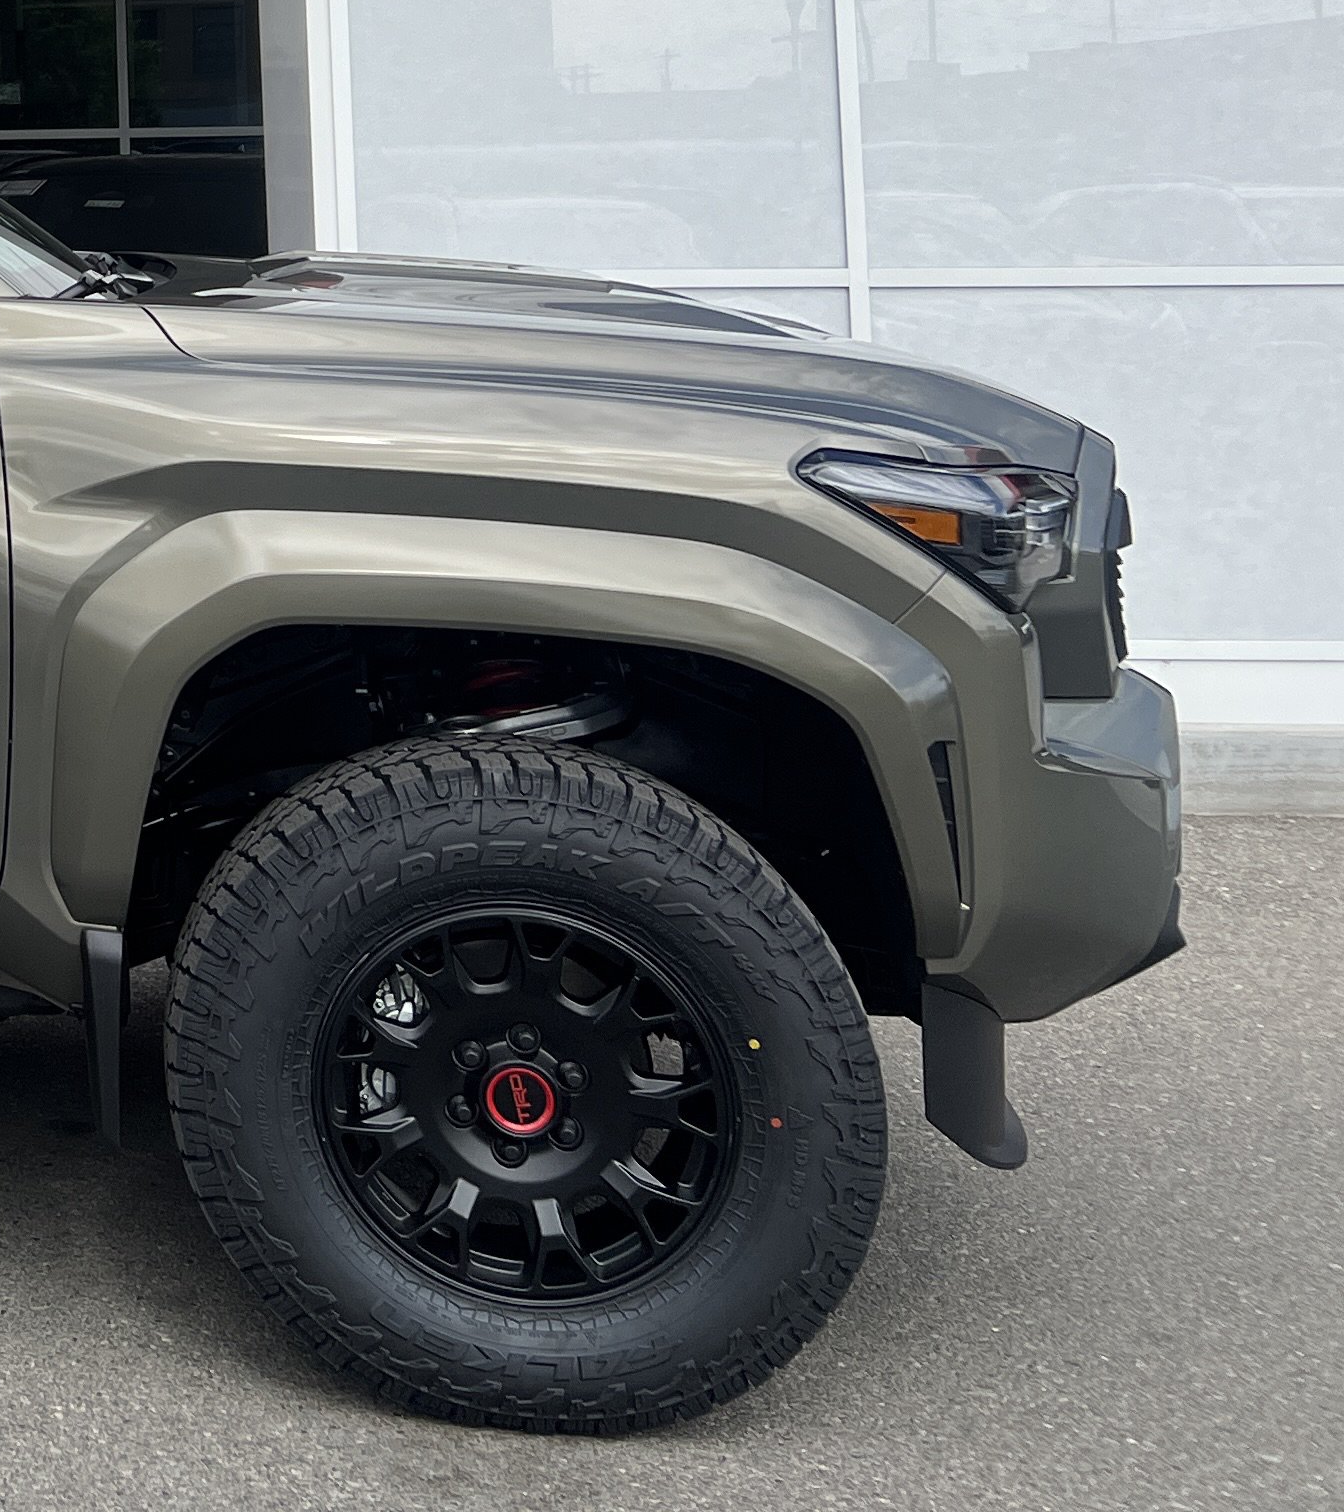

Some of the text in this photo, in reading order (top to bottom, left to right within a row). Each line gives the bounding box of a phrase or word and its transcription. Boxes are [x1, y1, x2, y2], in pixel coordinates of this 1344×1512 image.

[298, 839, 613, 956] WILDPEAK
[619, 876, 738, 949] A/T
[509, 1074, 532, 1124] TRD
